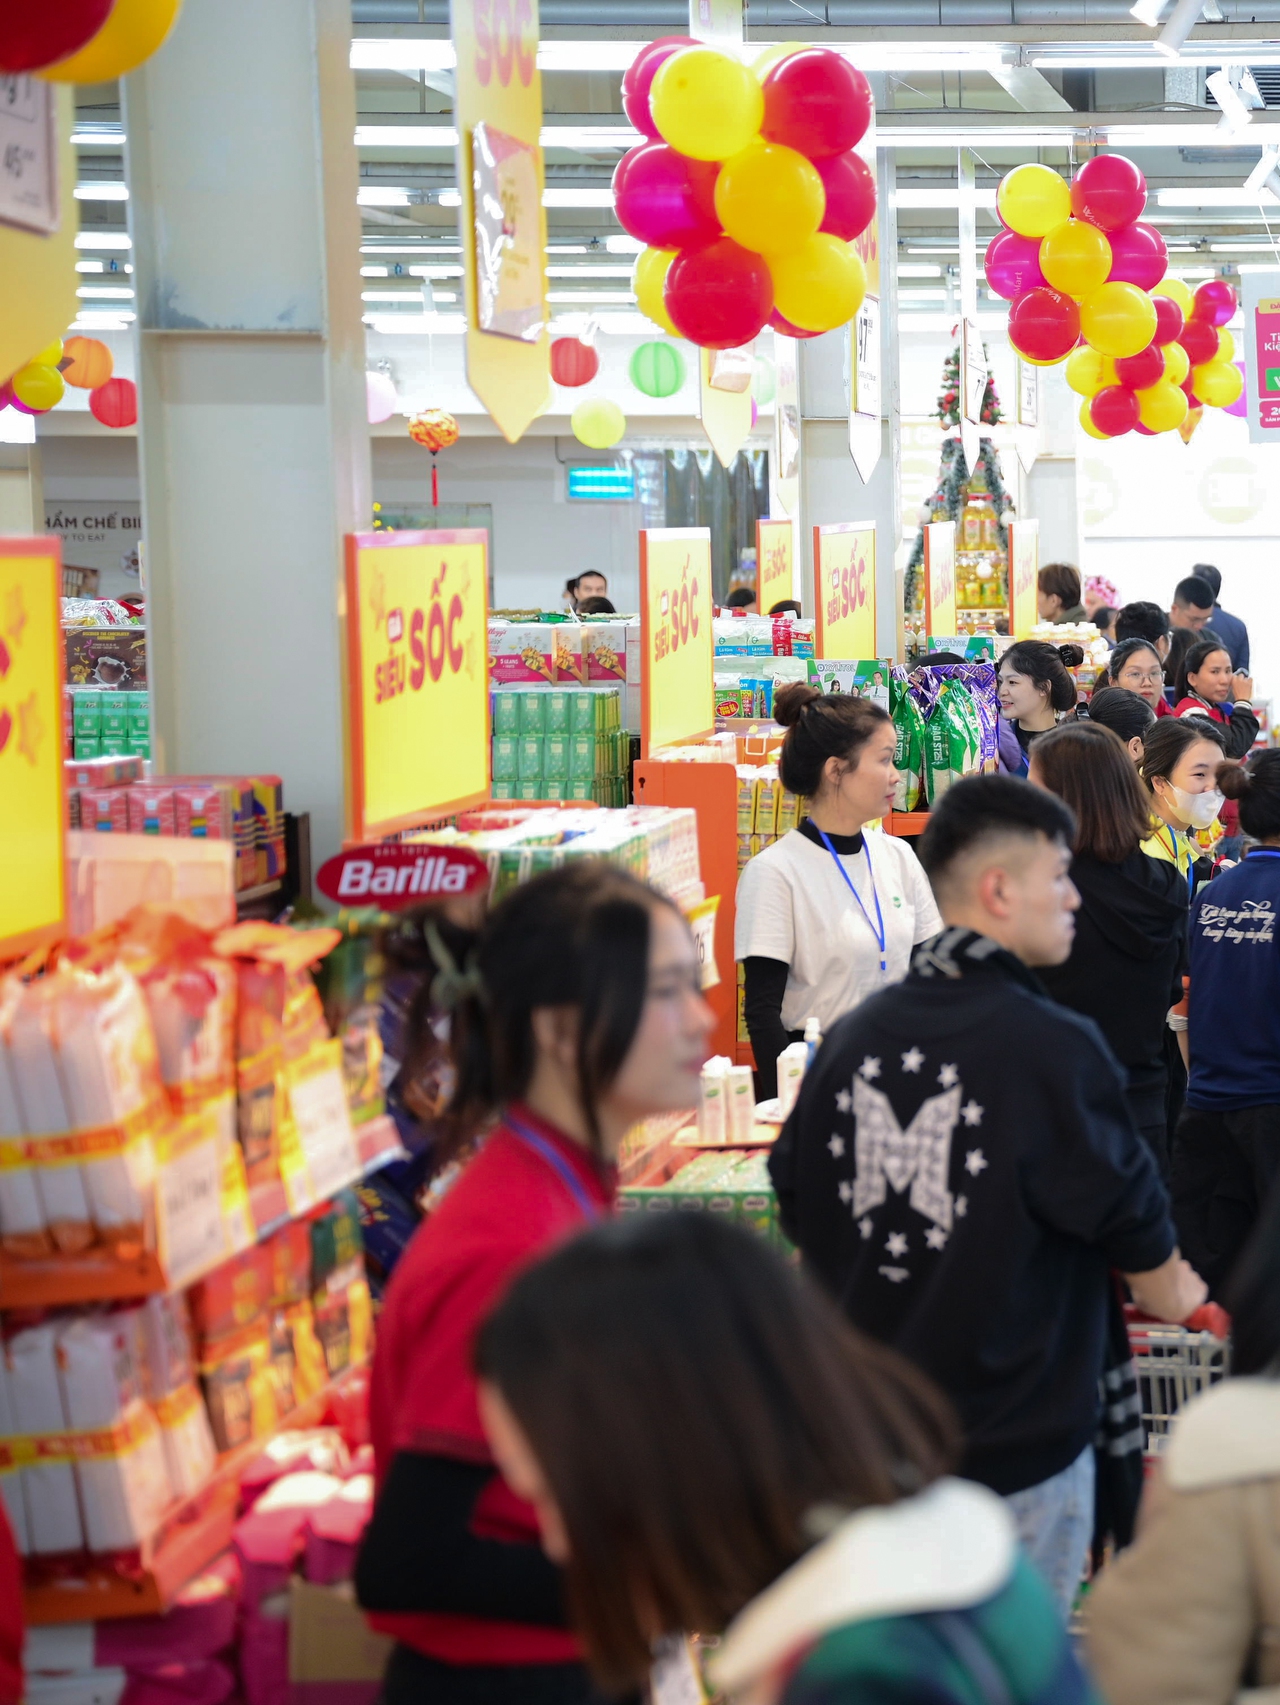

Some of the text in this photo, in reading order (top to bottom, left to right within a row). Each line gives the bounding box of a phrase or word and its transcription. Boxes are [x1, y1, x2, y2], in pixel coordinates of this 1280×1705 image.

[44, 509, 141, 529] HẨM CHẾ BI
[671, 552, 699, 652] SỐC
[841, 538, 865, 619] SỐC
[408, 561, 464, 692] SỐC
[337, 856, 468, 897] Barilla
